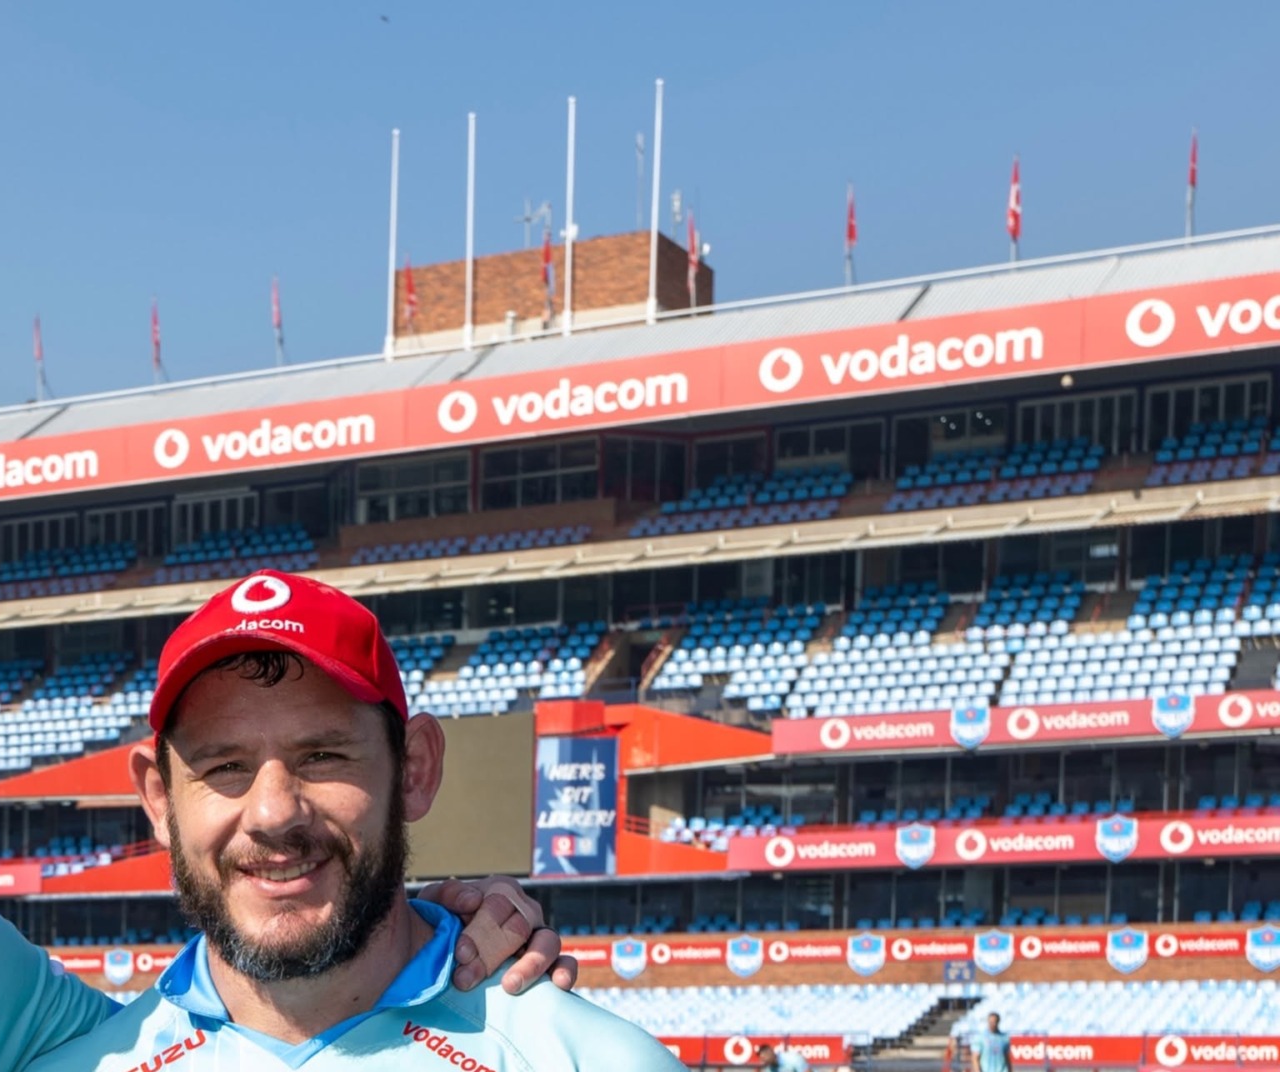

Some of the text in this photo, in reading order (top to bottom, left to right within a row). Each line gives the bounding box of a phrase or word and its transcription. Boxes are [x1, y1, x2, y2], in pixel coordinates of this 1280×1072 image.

[821, 326, 1043, 385] vodacom
[493, 372, 688, 425] vodacom
[202, 414, 375, 462] vodacom
[223, 618, 305, 634] dacom
[1041, 709, 1129, 731] vodacom
[852, 721, 935, 740] vodacom
[796, 840, 876, 859] vodacom
[988, 832, 1074, 852] vodacom
[1043, 938, 1101, 954] vodacom
[1179, 936, 1240, 952] vodacom
[1190, 1042, 1279, 1061] vodacom
